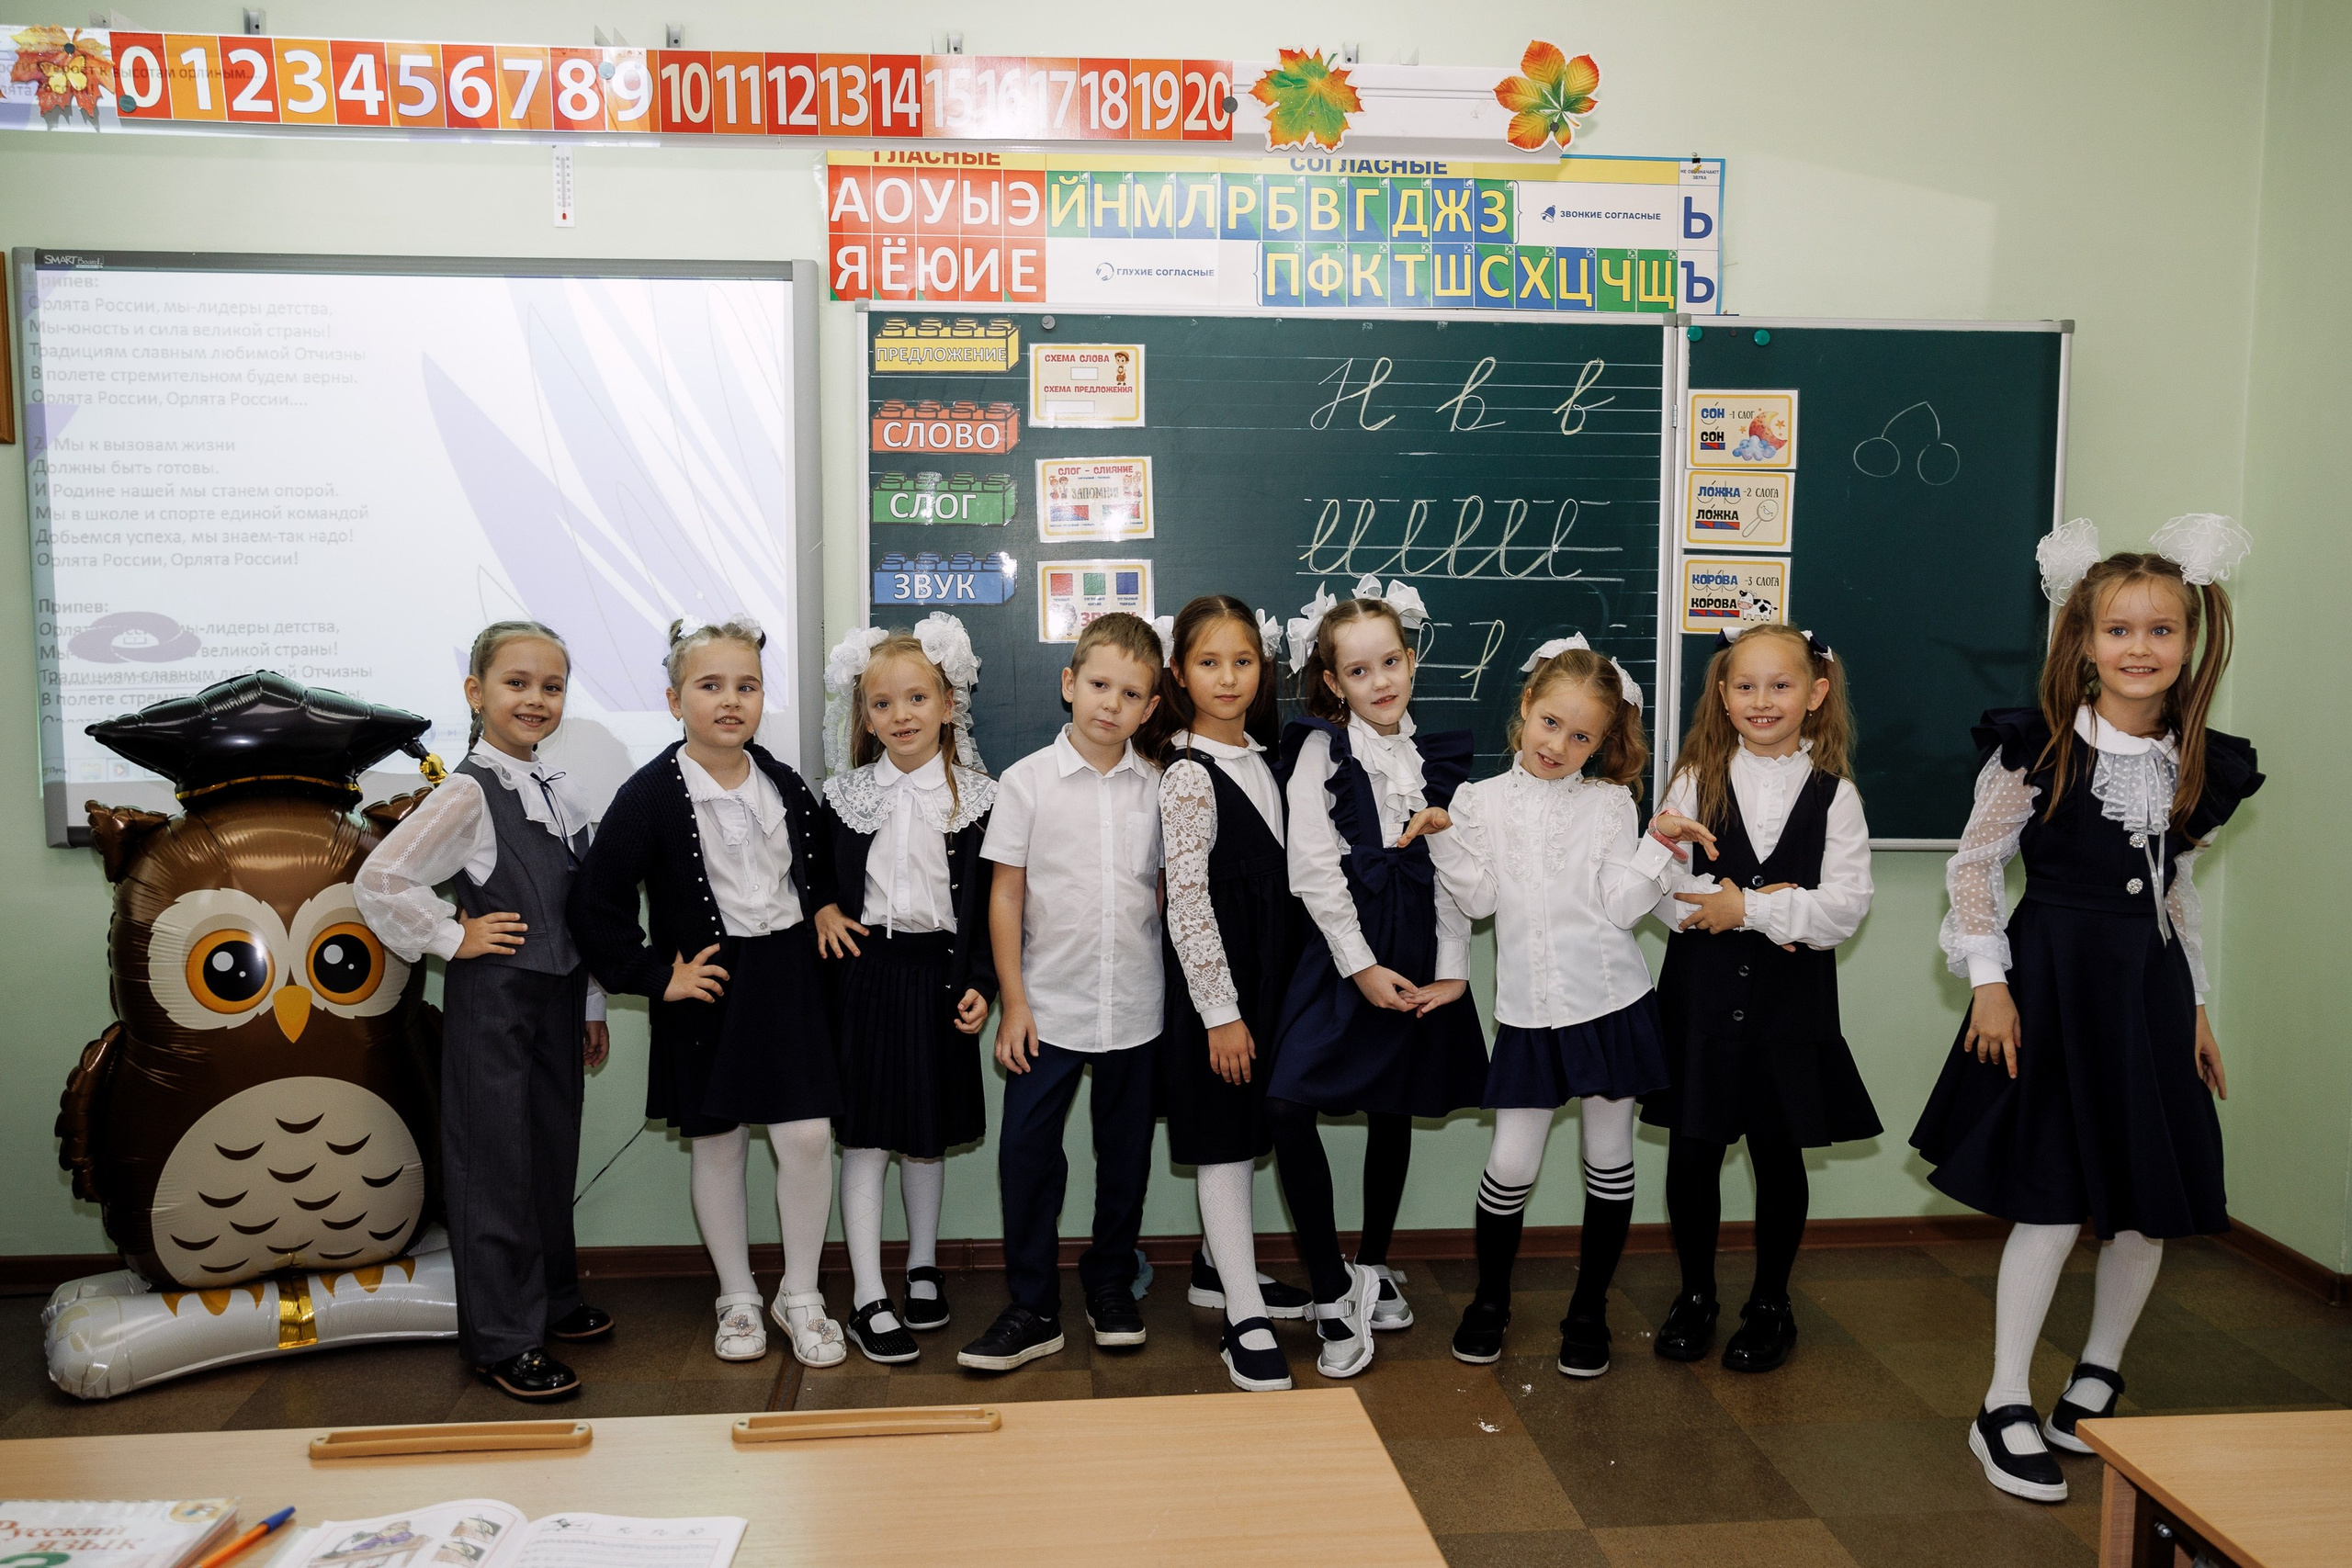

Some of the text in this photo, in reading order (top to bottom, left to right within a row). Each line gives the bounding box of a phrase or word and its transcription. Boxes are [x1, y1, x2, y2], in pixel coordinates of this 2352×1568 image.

[119, 46, 163, 107] 0
[179, 48, 212, 110] 1
[228, 49, 273, 112] 2
[286, 49, 328, 115] 3
[338, 53, 385, 116] 4
[398, 54, 439, 116] 5
[444, 56, 494, 119] 6
[501, 59, 544, 119] 7
[558, 59, 600, 121] 8
[610, 61, 654, 122] 9
[661, 62, 711, 123] 10
[715, 63, 763, 125] 11
[766, 64, 818, 125] 12
[820, 65, 869, 127] 13
[871, 66, 921, 128] 14
[924, 67, 974, 129] 15
[1029, 70, 1077, 130] 17
[1080, 69, 1129, 130] 18
[1132, 70, 1181, 131] 19
[1184, 71, 1231, 131] 20
[830, 177, 1040, 226] А О У Ы Э
[1051, 175, 1508, 238] Й Н М Л Р Б В Г Д Ж З
[1560, 209, 1661, 220] ЗВОНКИЕ СОГЛАСНЫЕ
[1683, 196, 1713, 239] Ь
[44, 255, 77, 265] SMART
[835, 237, 1037, 293] Я Ё Ю И Е
[1116, 268, 1215, 276] ГЛУХИЕ СОГЛАСНЫЕ
[1266, 253, 1675, 310] П Ф К Т Ш С Х Ц Ч Щ
[1680, 261, 1715, 303] Ъ
[96, 298, 161, 315] России,
[165, 301, 262, 316] мы-лидеры
[266, 302, 333, 317] детства,
[29, 320, 130, 334] Мы-юность
[149, 324, 188, 336] сила
[192, 321, 262, 337] великой
[266, 323, 331, 340] страны!
[28, 342, 366, 361] Традициям славным любимой Отчизны
[876, 347, 1008, 365] ПРЕДЛОЖЕНИЕ
[1045, 355, 1110, 363] СХЕМА СЛОВА
[47, 371, 106, 381] полете
[110, 371, 243, 385] стремительном
[247, 368, 297, 386] будем
[303, 372, 358, 386] верны.
[1074, 386, 1133, 394] ПРЕДЛОЖЕНИЯ
[98, 391, 162, 408] России,
[166, 391, 225, 408] Орлята
[882, 421, 1001, 449] СЛОВО
[103, 441, 177, 451] вызовам
[182, 441, 235, 451] жизни
[33, 459, 219, 476] Должны быть готовы.
[1057, 466, 1134, 475] СЛОГ СЛИЯНИЕ
[53, 483, 115, 500] Родине
[120, 482, 175, 497] нашей
[180, 487, 206, 497] мы
[211, 487, 269, 497] станем
[274, 482, 339, 500] опорой.
[1698, 486, 1741, 497] ЛОЖКА
[1756, 488, 1779, 498] СЛОГА
[86, 510, 139, 521] школе
[160, 510, 215, 523] спорте
[220, 504, 282, 523] единой
[288, 504, 368, 523] командой
[889, 492, 977, 520] СЛОГ
[1696, 509, 1739, 521] ЛОЖКА
[126, 533, 187, 546] успеха,
[191, 532, 217, 543] мы
[221, 532, 305, 543] знаем-так
[309, 528, 353, 545] надо!
[103, 553, 166, 568] России,
[170, 553, 230, 569] Орлята
[234, 550, 299, 566] России!
[894, 573, 976, 600] ЗВУК
[1692, 574, 1738, 585] КОРОВА
[1757, 577, 1779, 586] СЛОГА
[39, 598, 108, 615] Припев:
[1691, 598, 1736, 608] КОРОВА
[274, 623, 340, 636] детства,
[201, 641, 269, 658] великой
[275, 641, 338, 659] страны!
[302, 665, 373, 679] Отчизны
